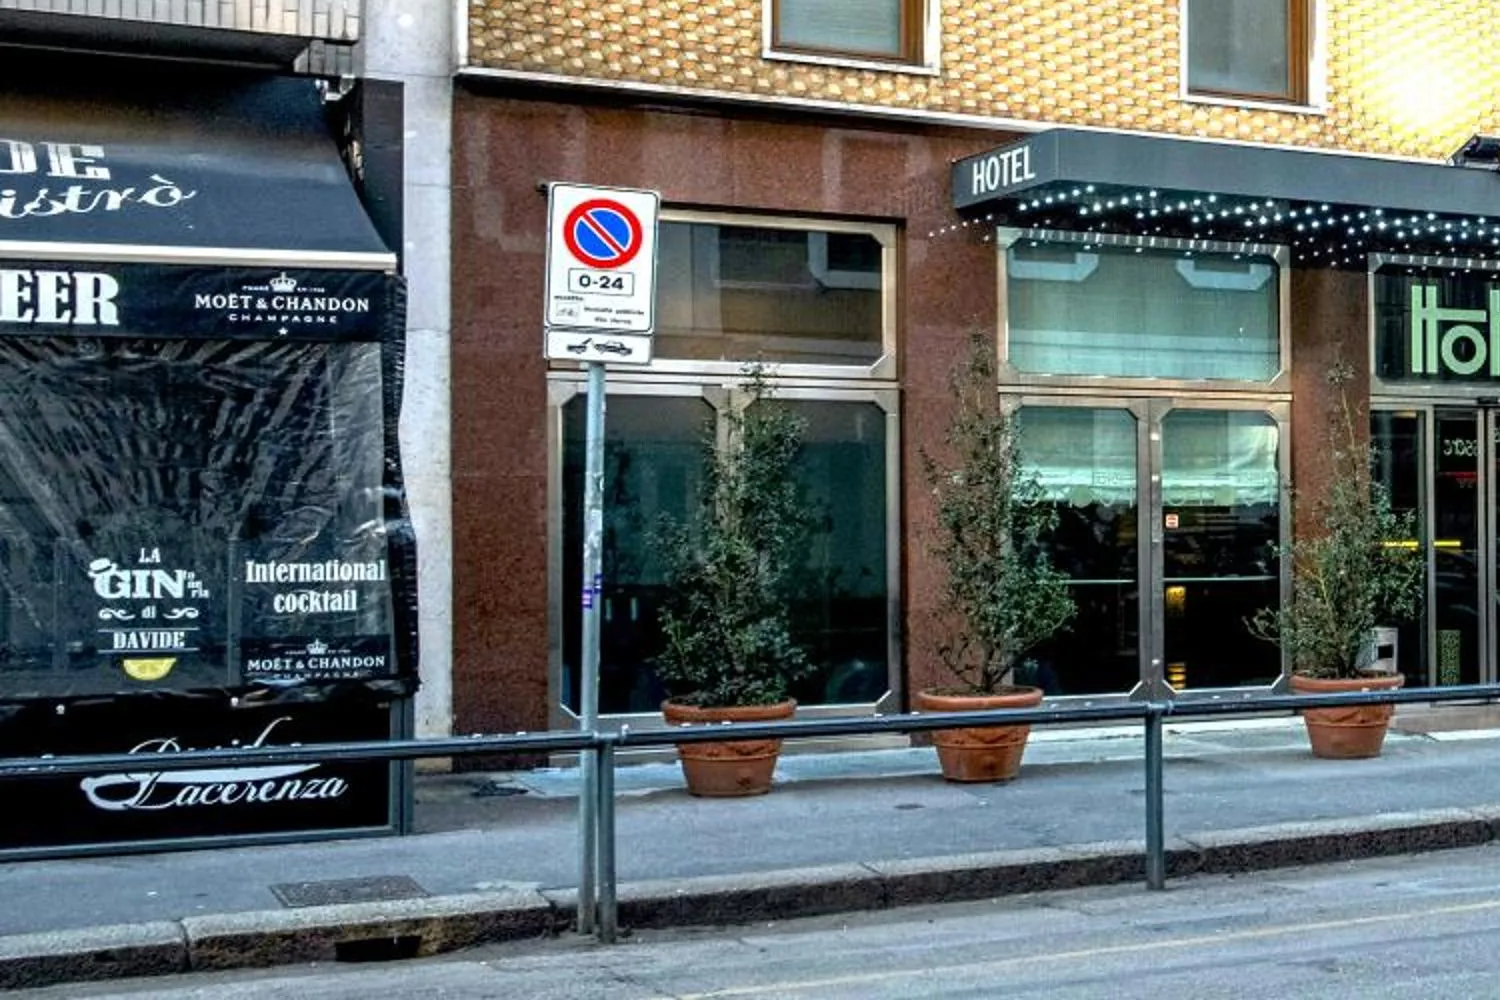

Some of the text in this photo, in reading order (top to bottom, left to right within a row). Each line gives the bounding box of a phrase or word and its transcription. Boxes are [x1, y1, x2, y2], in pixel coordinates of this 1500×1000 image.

[972, 146, 1036, 195] HOTEL
[271, 294, 370, 313] CHANDON
[228, 313, 338, 325] CHAMPAGNE
[138, 547, 161, 563] LA
[245, 559, 386, 583] International
[273, 589, 358, 613] cocktail
[141, 605, 157, 619] di
[113, 631, 186, 649] DAVIDE
[307, 655, 385, 670] CHANDON
